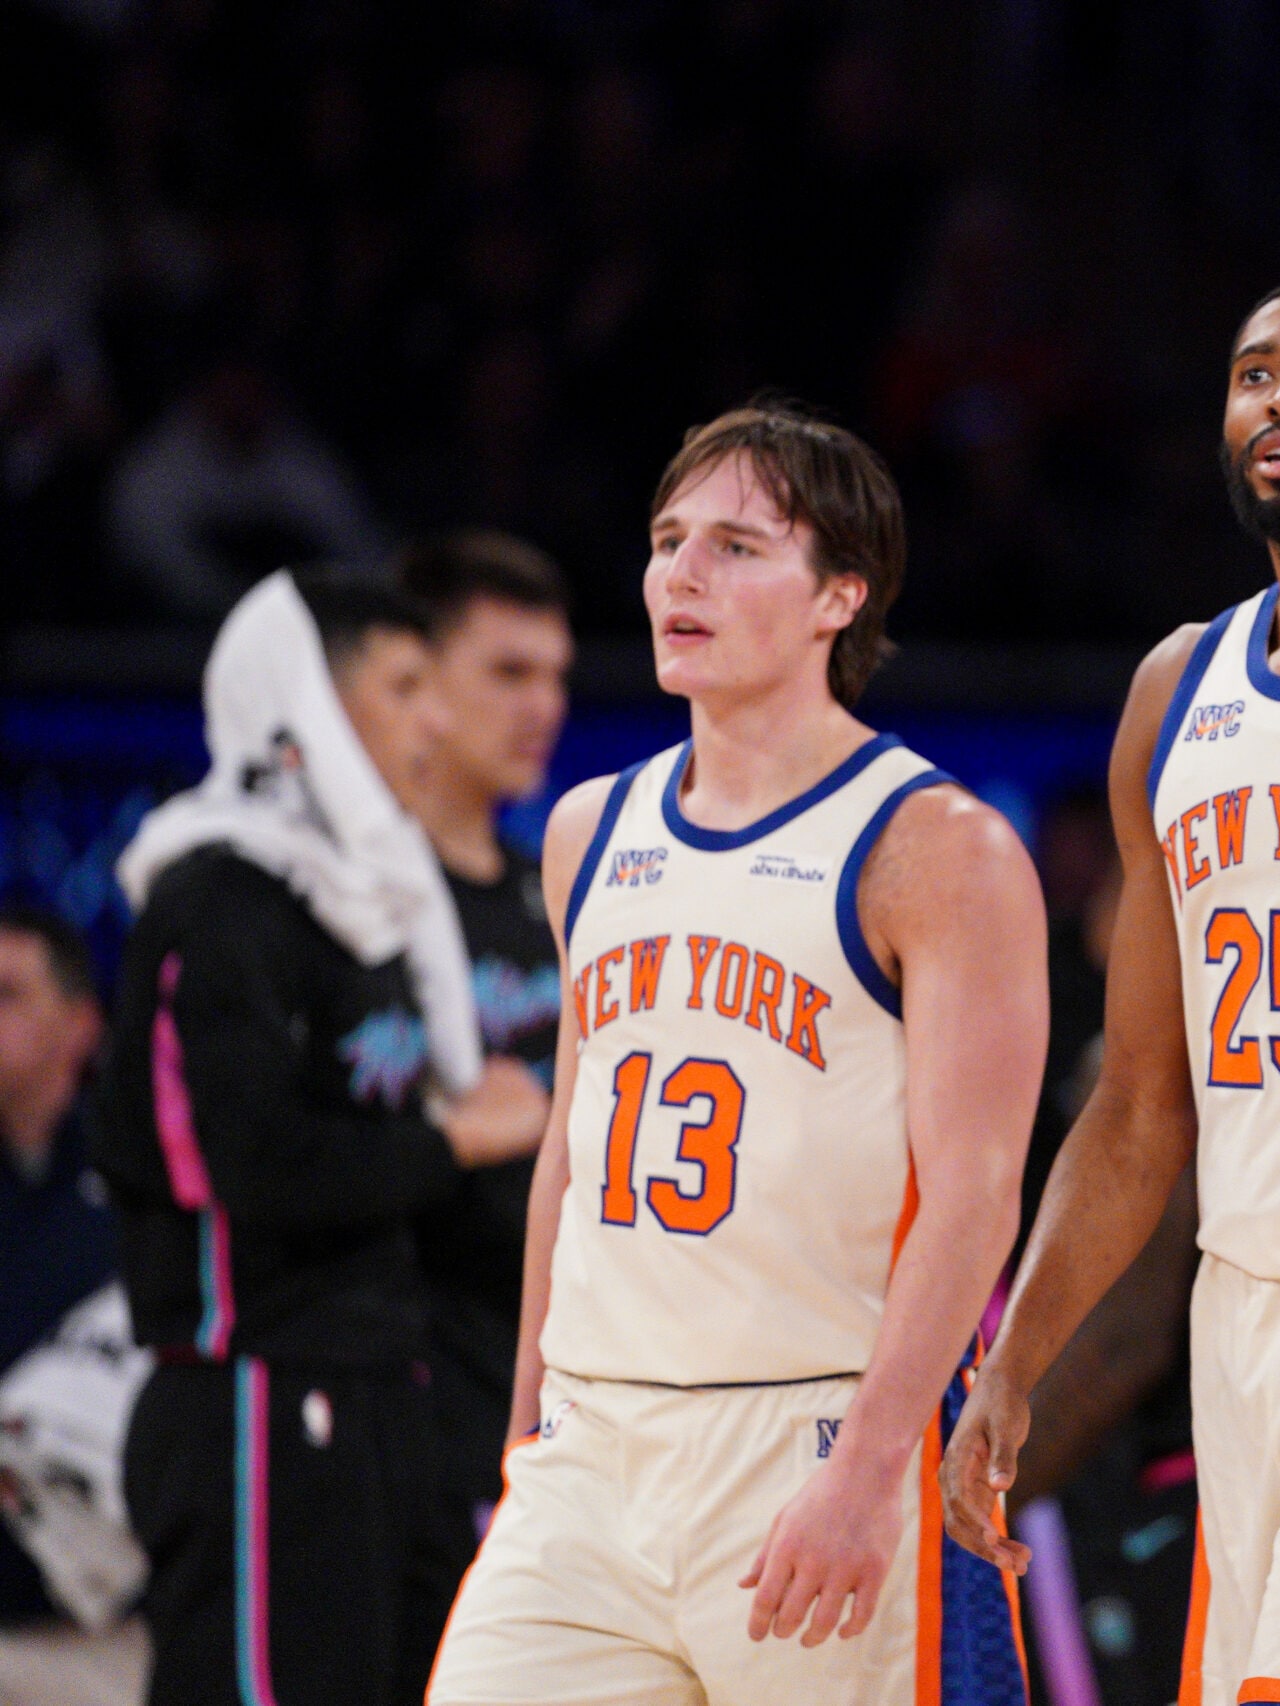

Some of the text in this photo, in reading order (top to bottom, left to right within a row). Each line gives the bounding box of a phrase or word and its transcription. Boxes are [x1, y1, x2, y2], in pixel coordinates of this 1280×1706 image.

[1184, 700, 1245, 741] NYC
[1161, 785, 1252, 911] NEW
[574, 934, 671, 1041] NEW
[687, 934, 832, 1072] YORK
[600, 1050, 746, 1236] 13
